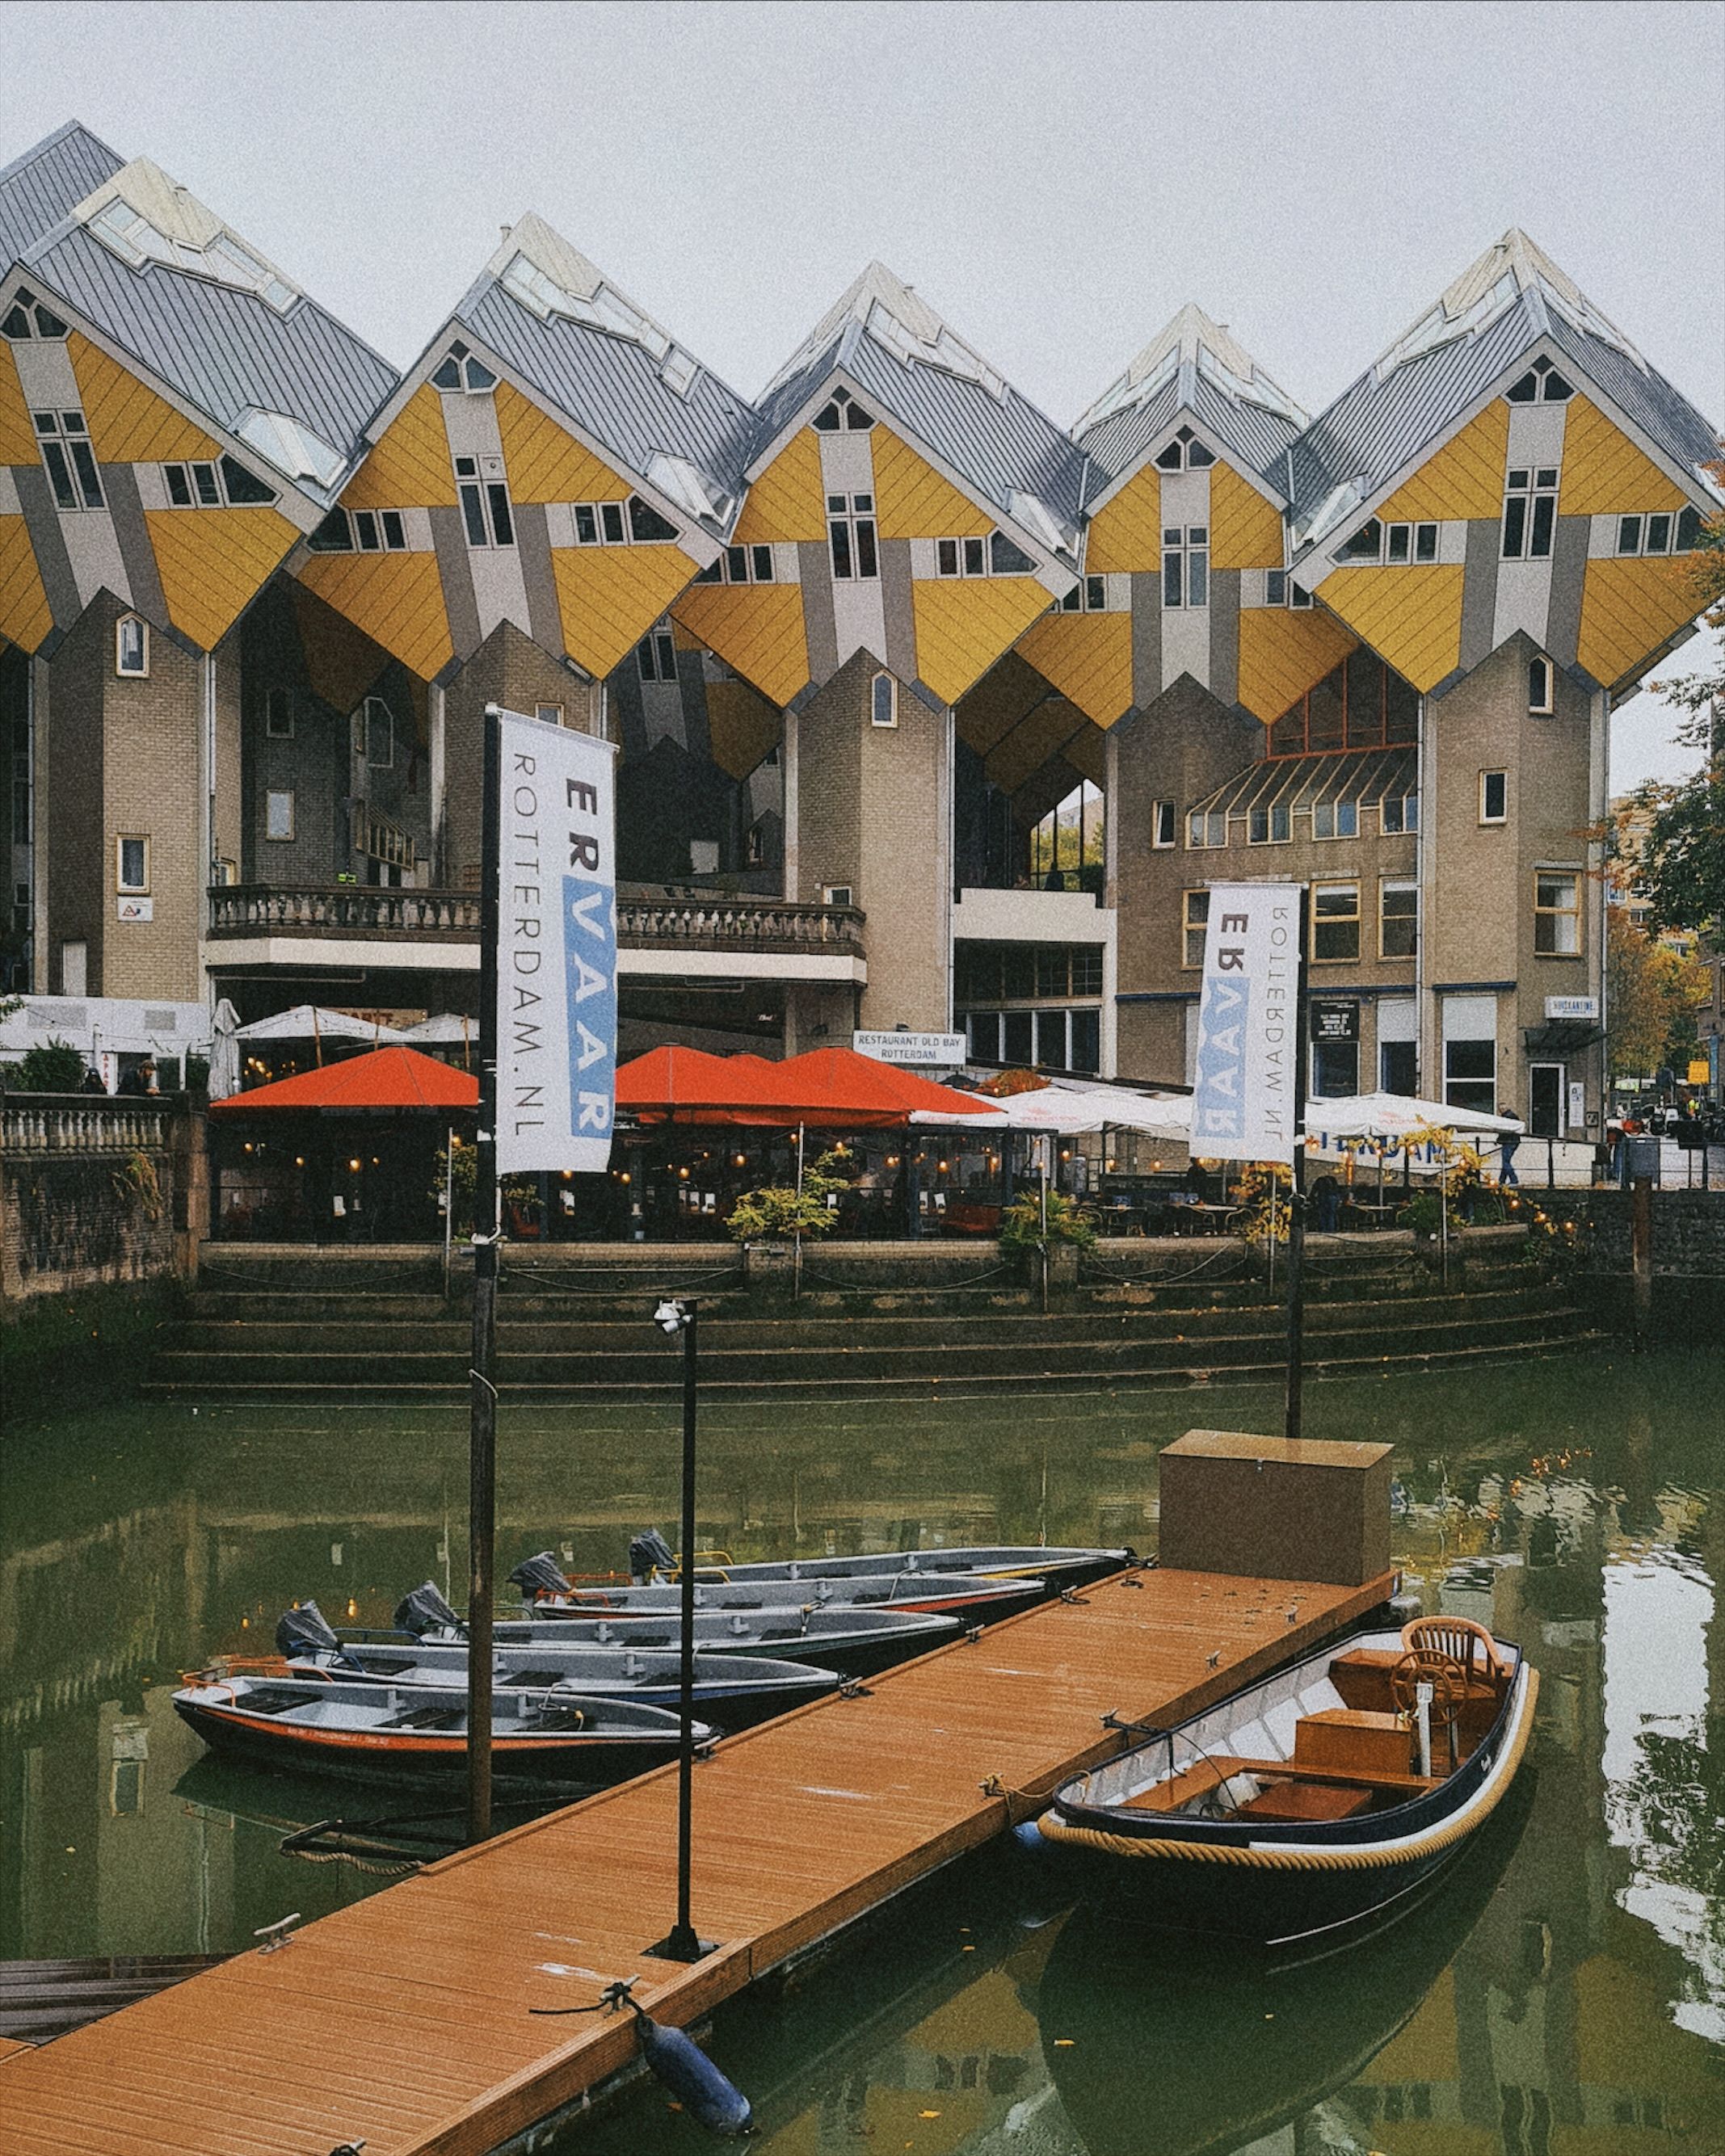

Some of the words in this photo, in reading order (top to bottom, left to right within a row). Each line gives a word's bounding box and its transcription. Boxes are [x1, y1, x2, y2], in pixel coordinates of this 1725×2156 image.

[513, 753, 545, 1137] ROTTERDAM.NL
[566, 777, 609, 1131] ERVAAR
[858, 1035, 919, 1046] RESTAURANT
[922, 1037, 940, 1047] OLD
[943, 1037, 961, 1047] BAY
[881, 1049, 937, 1060] ROTTERDAM
